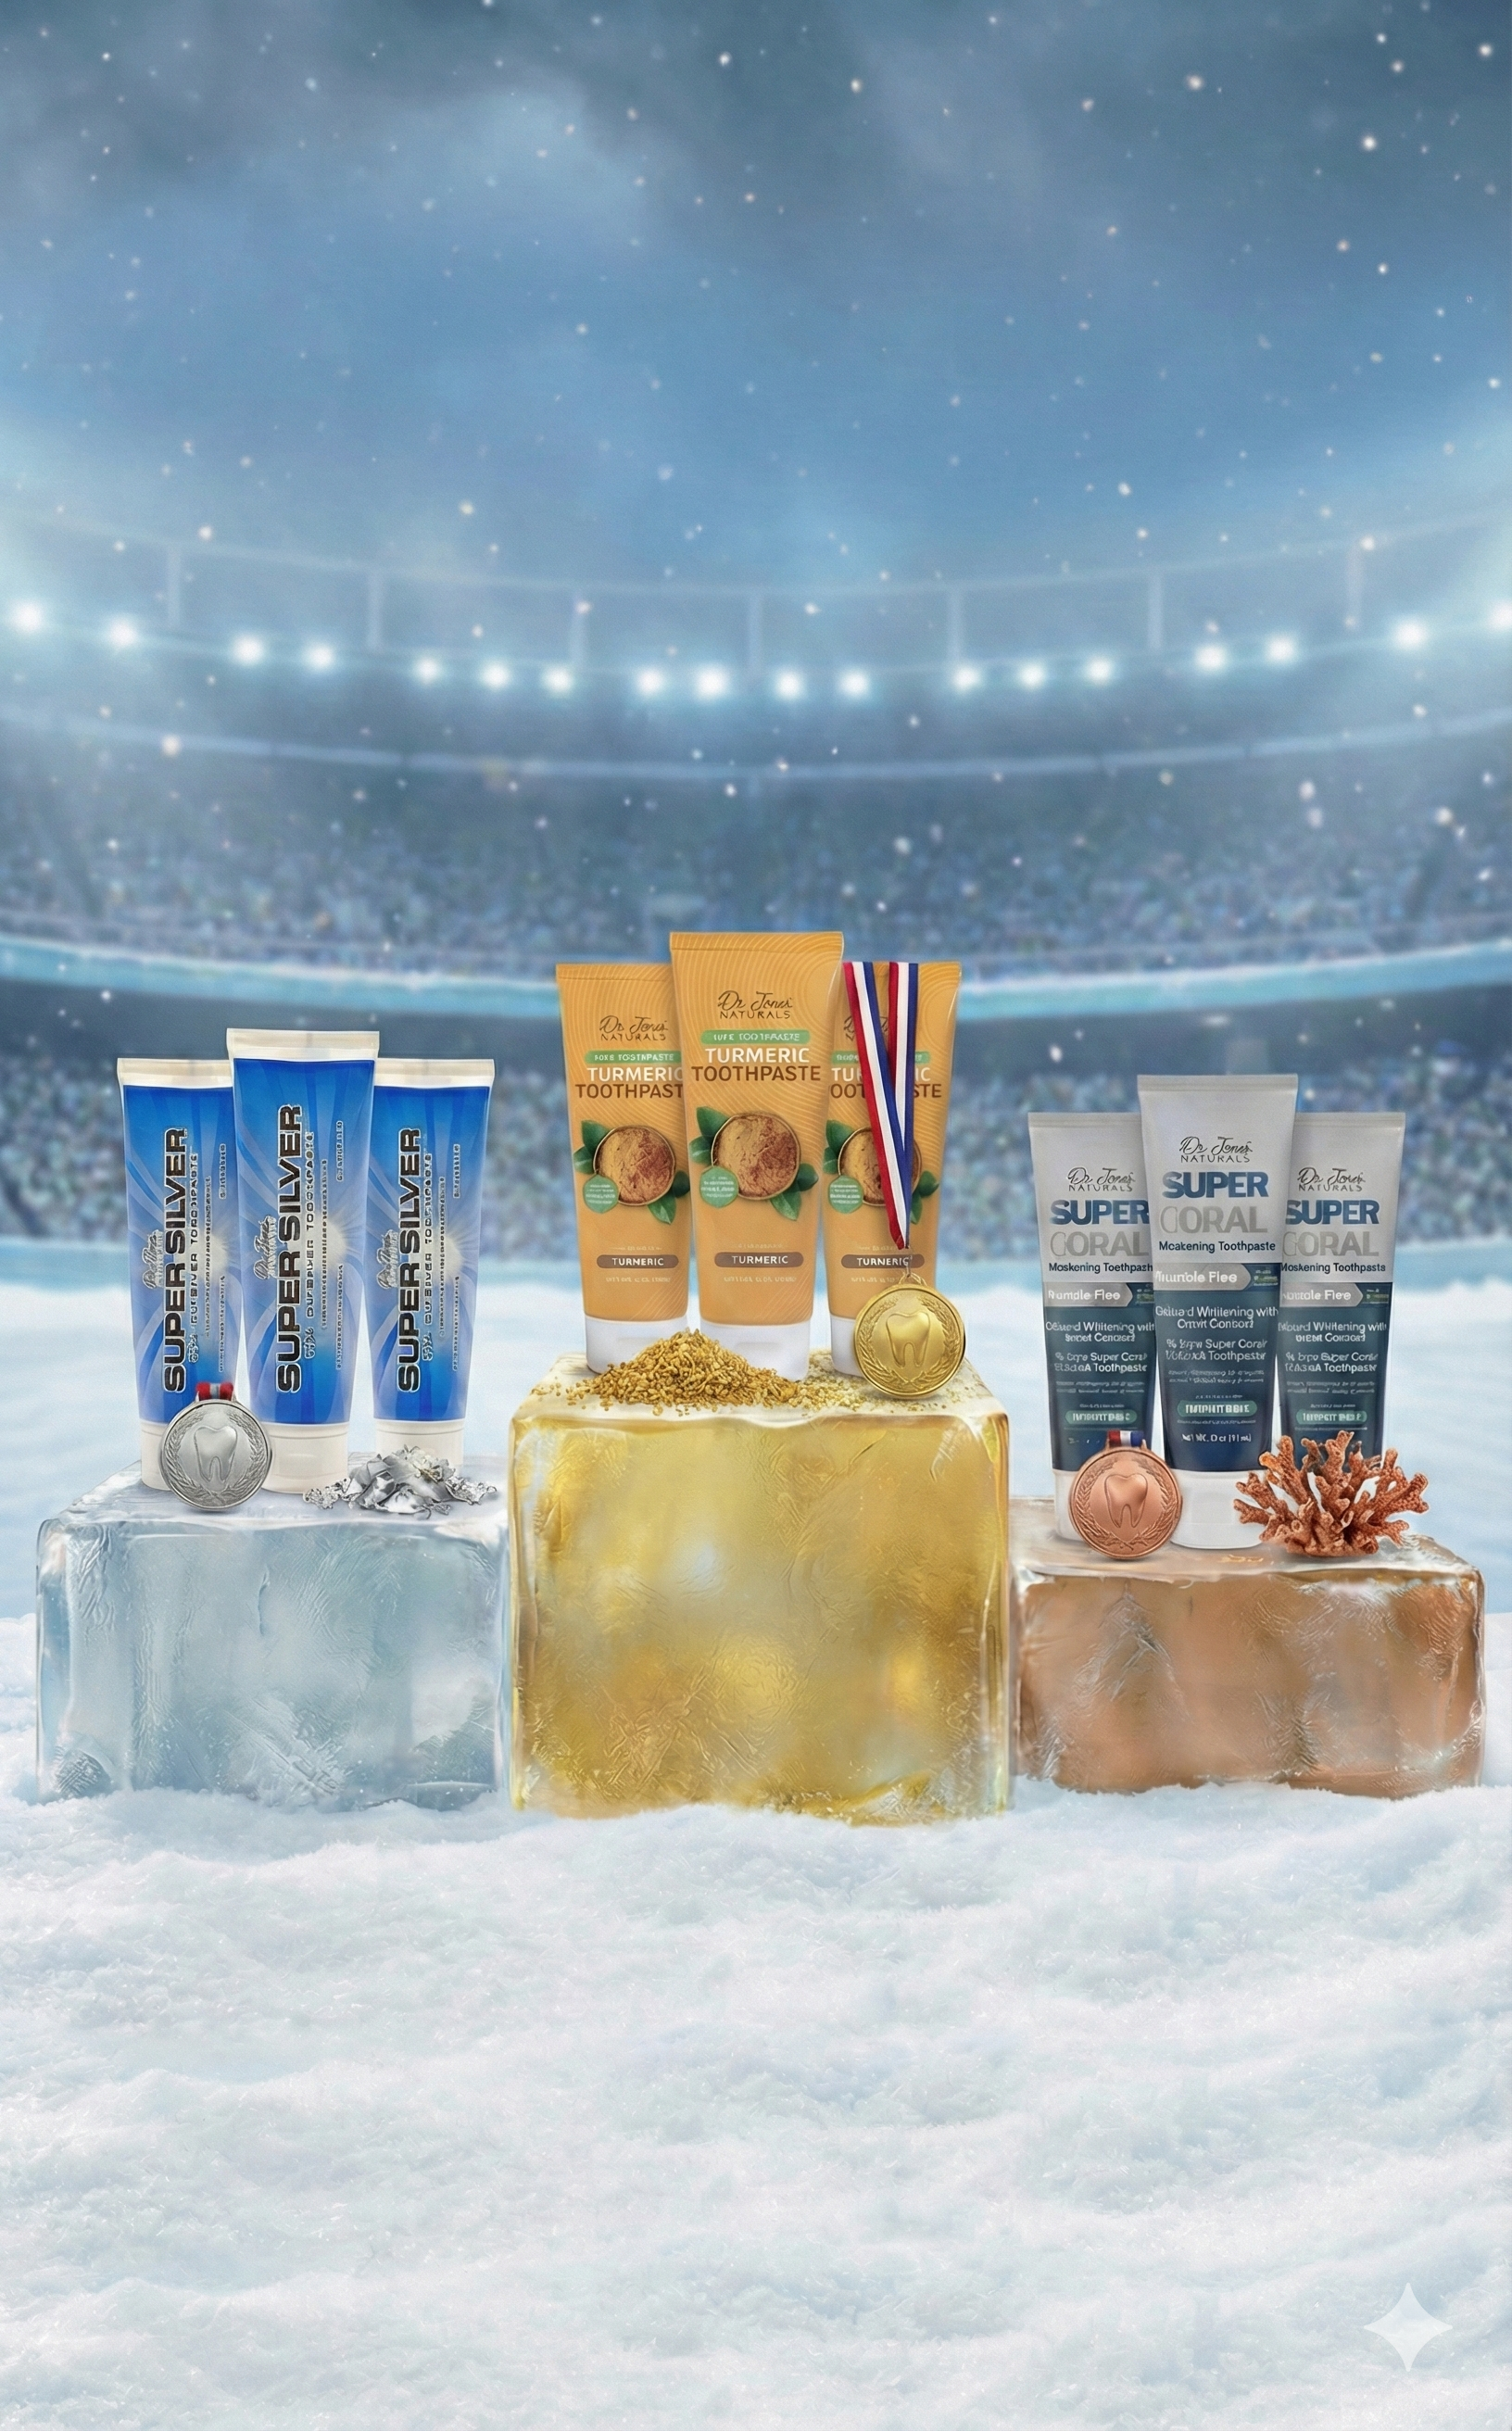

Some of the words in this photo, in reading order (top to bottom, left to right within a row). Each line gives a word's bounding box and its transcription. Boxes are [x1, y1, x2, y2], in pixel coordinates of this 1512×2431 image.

[720, 1011, 790, 1019] NATURALS
[601, 1033, 666, 1042] NATURALS
[704, 1048, 810, 1064] TURMERIC
[586, 1066, 683, 1082] TURMERIC
[691, 1065, 821, 1081] TOOTHPASTE
[575, 1083, 683, 1099] TOOTHPAST
[276, 1104, 302, 1242] SILVER
[163, 1127, 187, 1254] SILVER
[397, 1127, 420, 1254] SILVER
[1069, 1184, 1133, 1192] NATURALS
[1162, 1171, 1269, 1199] SUPER
[1299, 1184, 1363, 1192] NATURALS
[1050, 1199, 1150, 1225] SUPER
[1160, 1205, 1268, 1233] CORAL
[1285, 1199, 1380, 1225] SUPER
[1218, 1241, 1276, 1253] Toothpaste
[732, 1255, 788, 1265] TURMERIC
[1255, 1306, 1279, 1316] with
[163, 1262, 186, 1392] SUPER
[276, 1251, 302, 1392] SUPER
[397, 1262, 420, 1392] SUPER
[1205, 1339, 1236, 1350] Super
